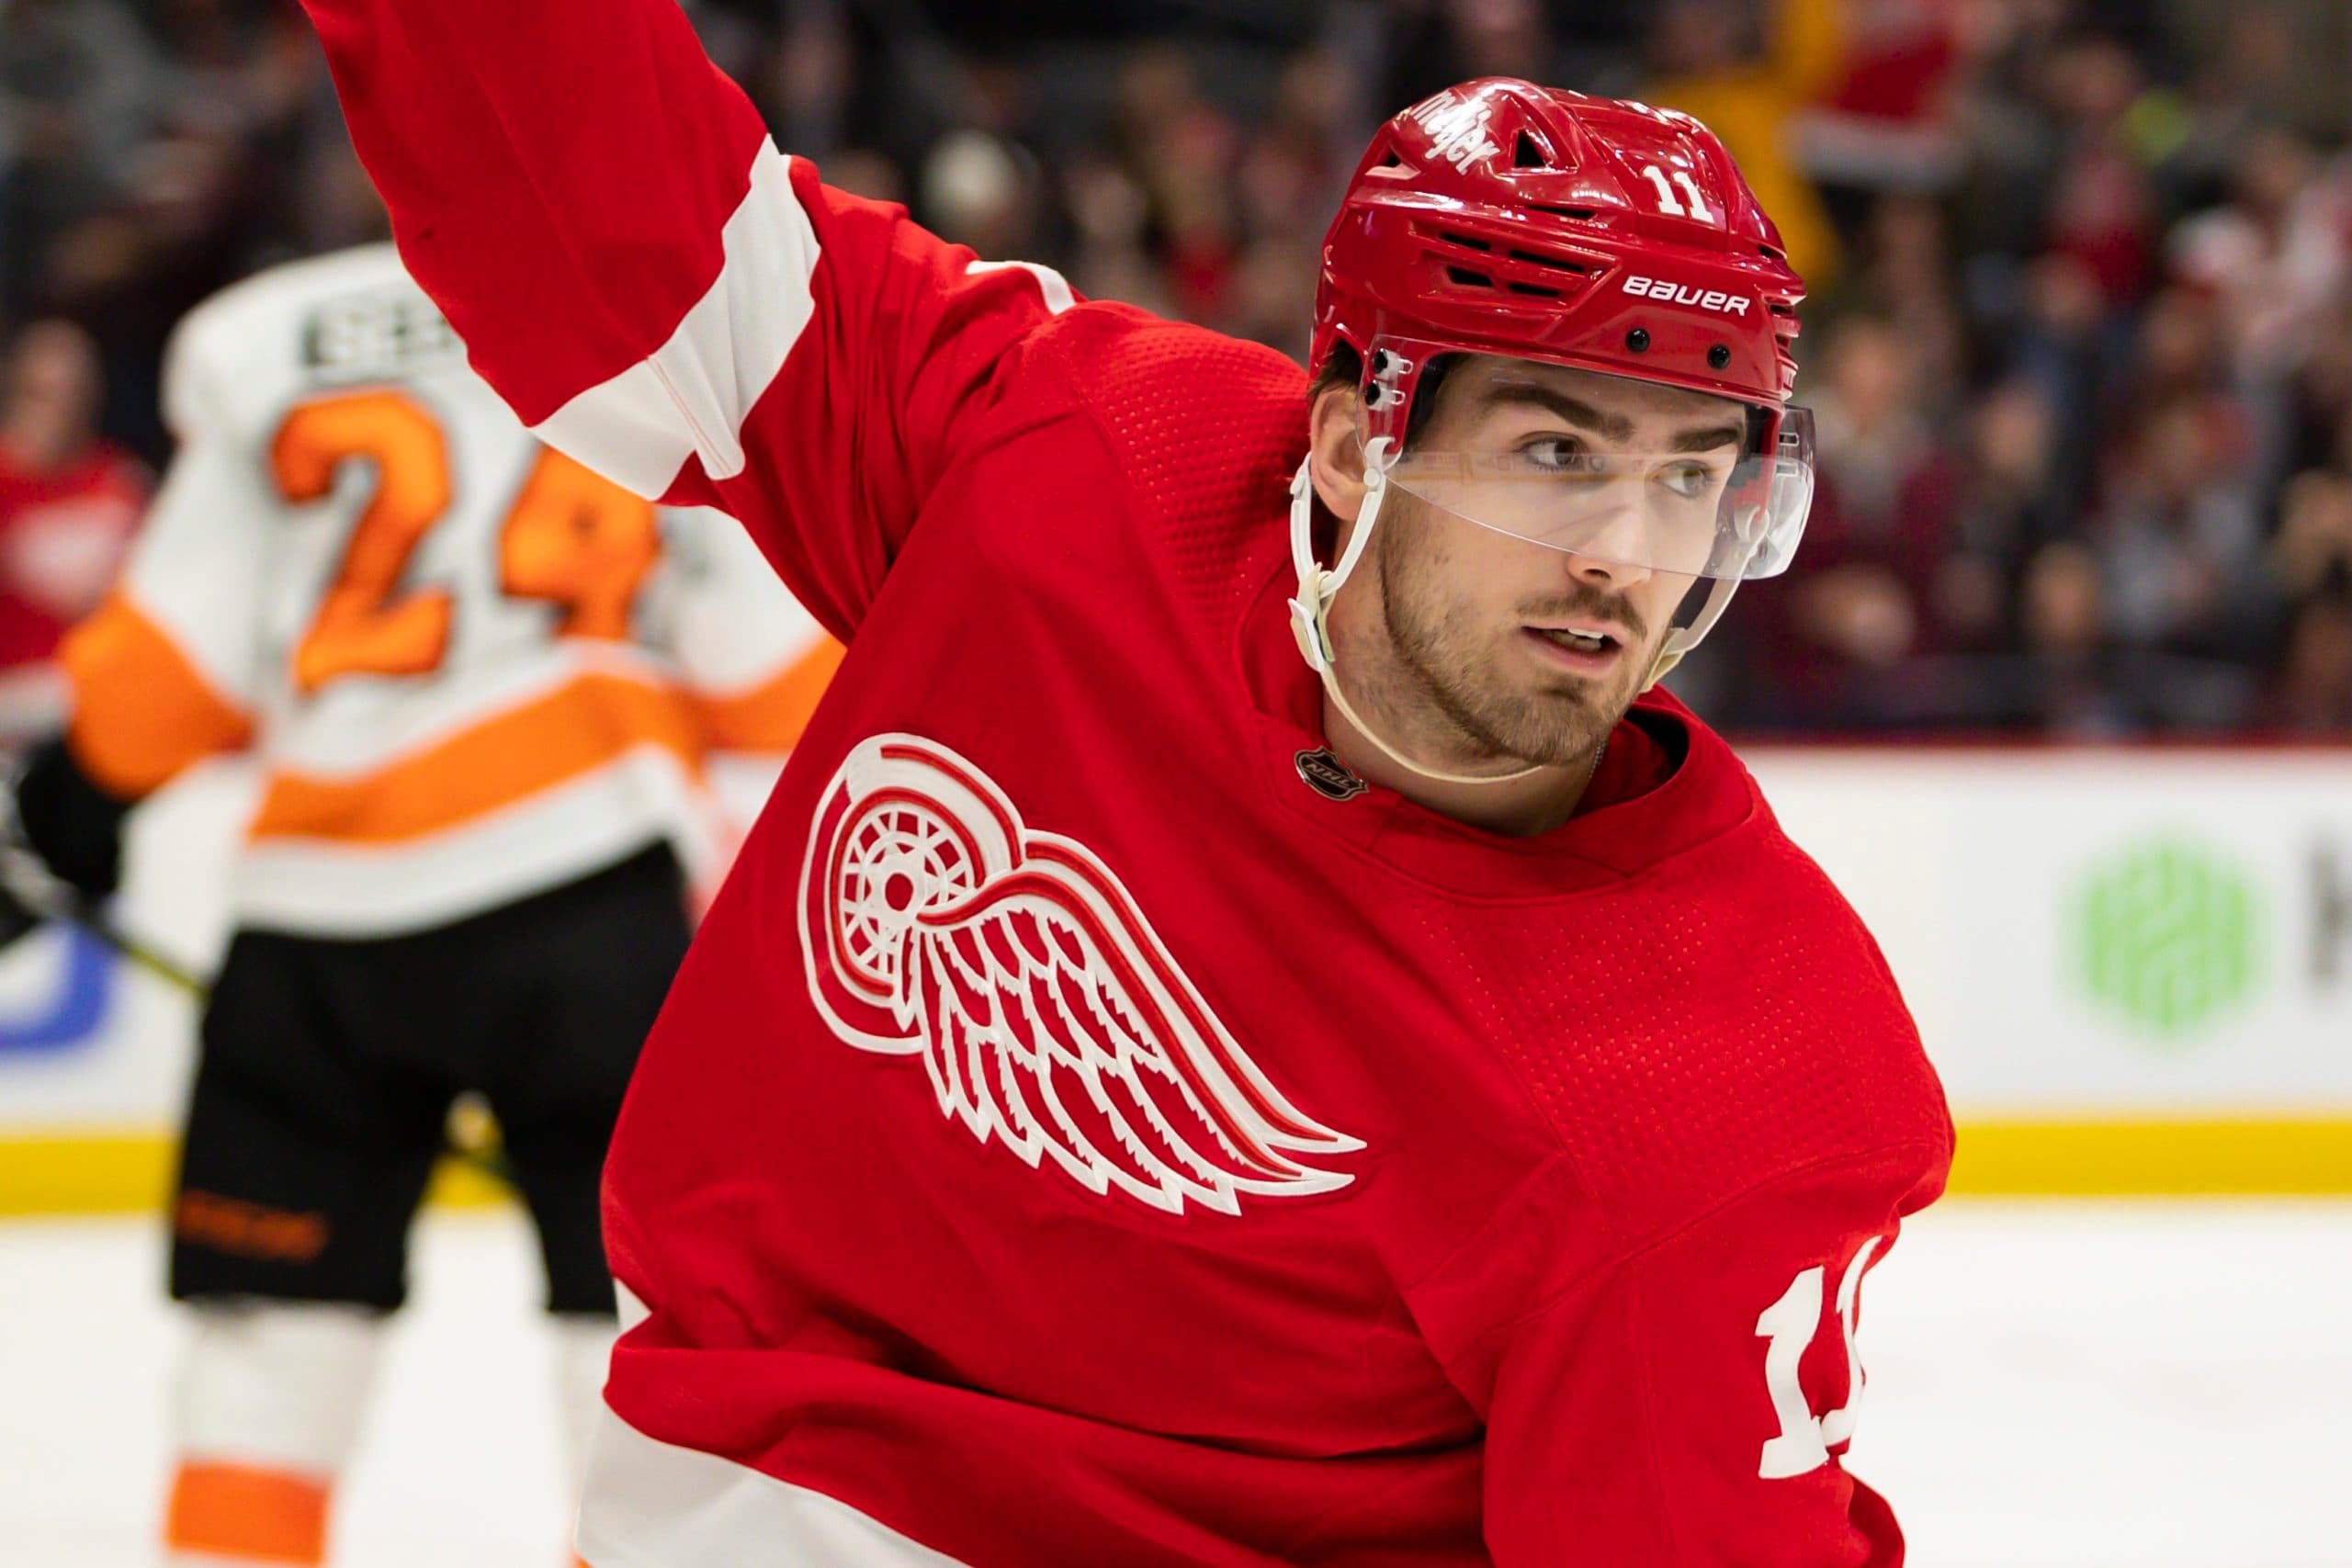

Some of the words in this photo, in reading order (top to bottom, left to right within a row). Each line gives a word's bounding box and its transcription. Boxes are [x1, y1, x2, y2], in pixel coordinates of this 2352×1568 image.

[1643, 165, 1715, 224] 11
[268, 388, 663, 698] 24
[1305, 762, 1351, 786] NHL
